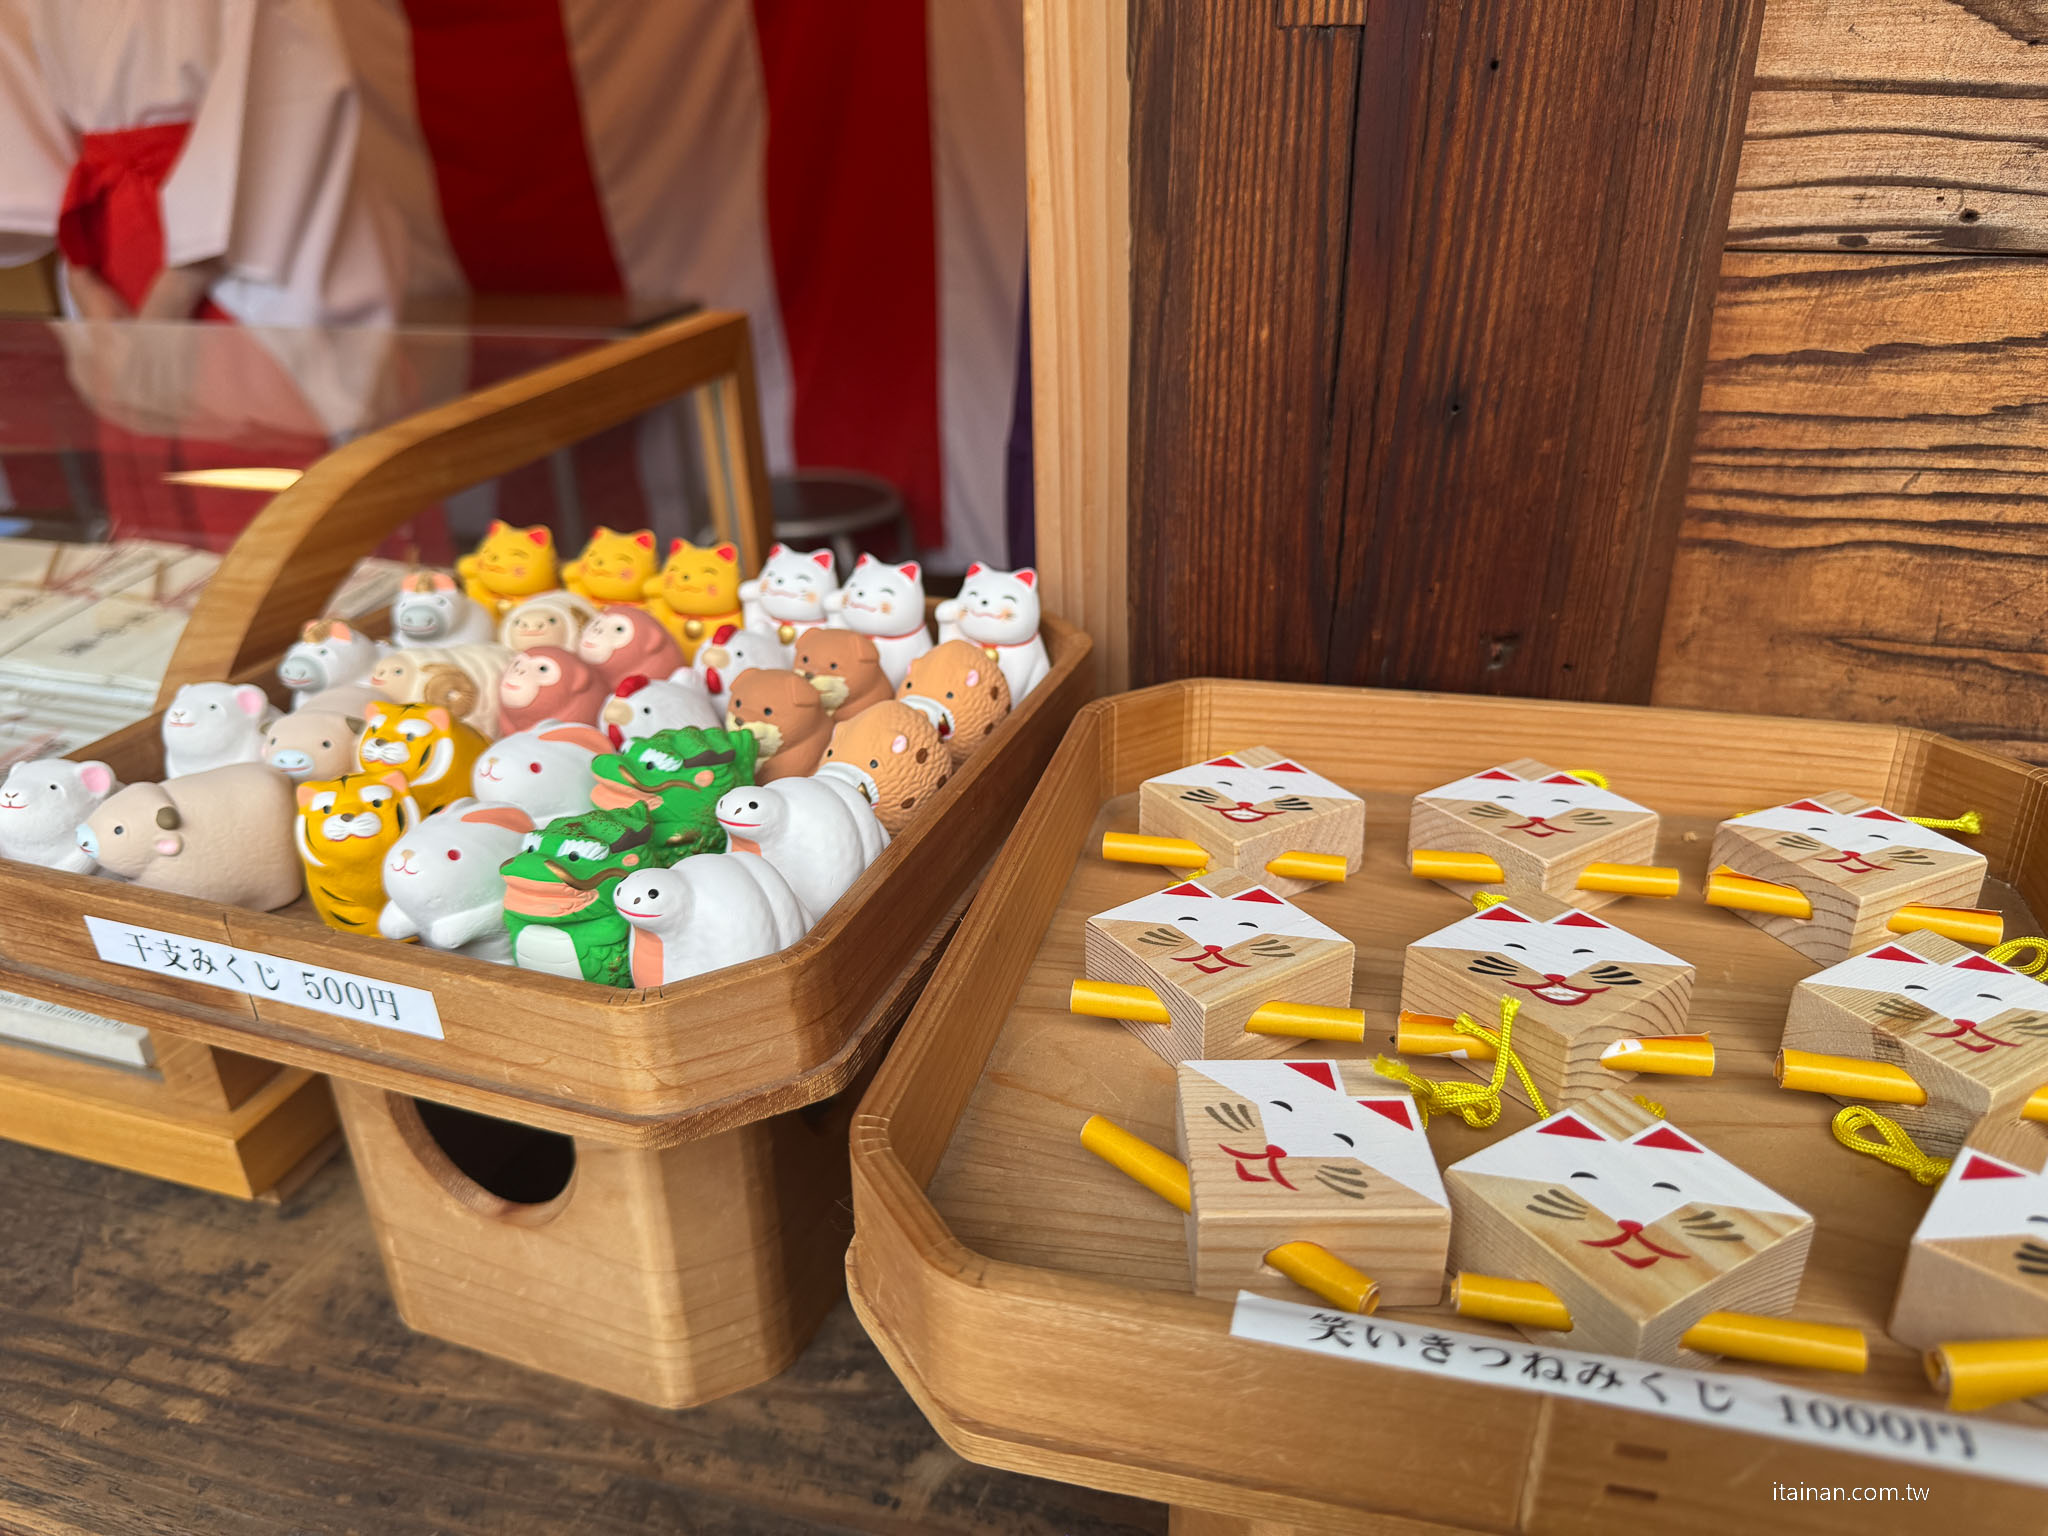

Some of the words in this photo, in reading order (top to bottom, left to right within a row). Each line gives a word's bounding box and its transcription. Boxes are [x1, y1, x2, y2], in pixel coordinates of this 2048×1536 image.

[124, 932, 281, 991] 干支みくじ
[302, 971, 400, 1021] 500円
[1308, 1312, 1735, 1413] 笑いきつねみくじ
[1778, 1394, 1977, 1459] 1000円
